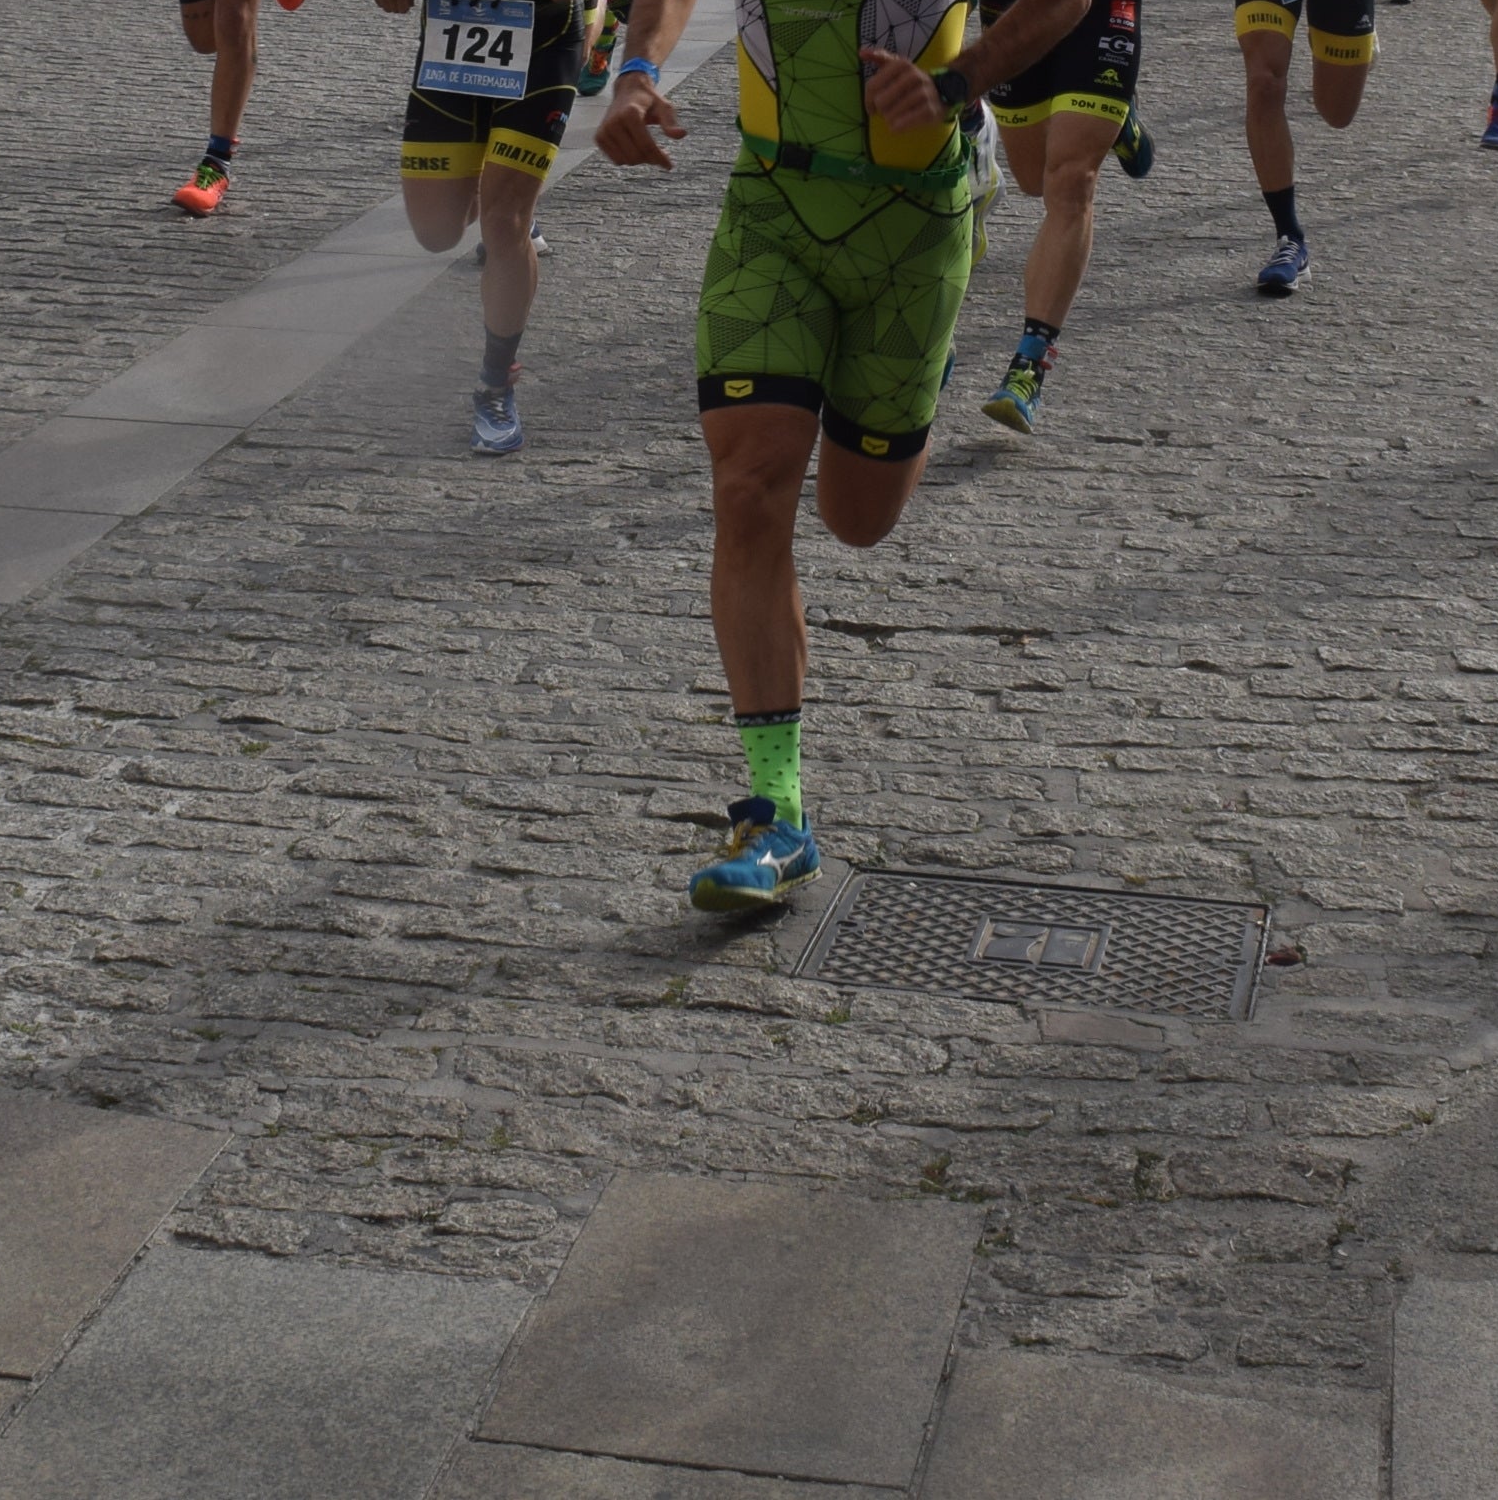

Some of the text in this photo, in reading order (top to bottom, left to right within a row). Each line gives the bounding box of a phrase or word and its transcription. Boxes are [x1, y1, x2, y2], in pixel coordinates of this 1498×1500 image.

[443, 23, 514, 67] 124
[424, 69, 521, 90] JUNTA DE EXTREMADURA
[1071, 98, 1096, 109] DON
